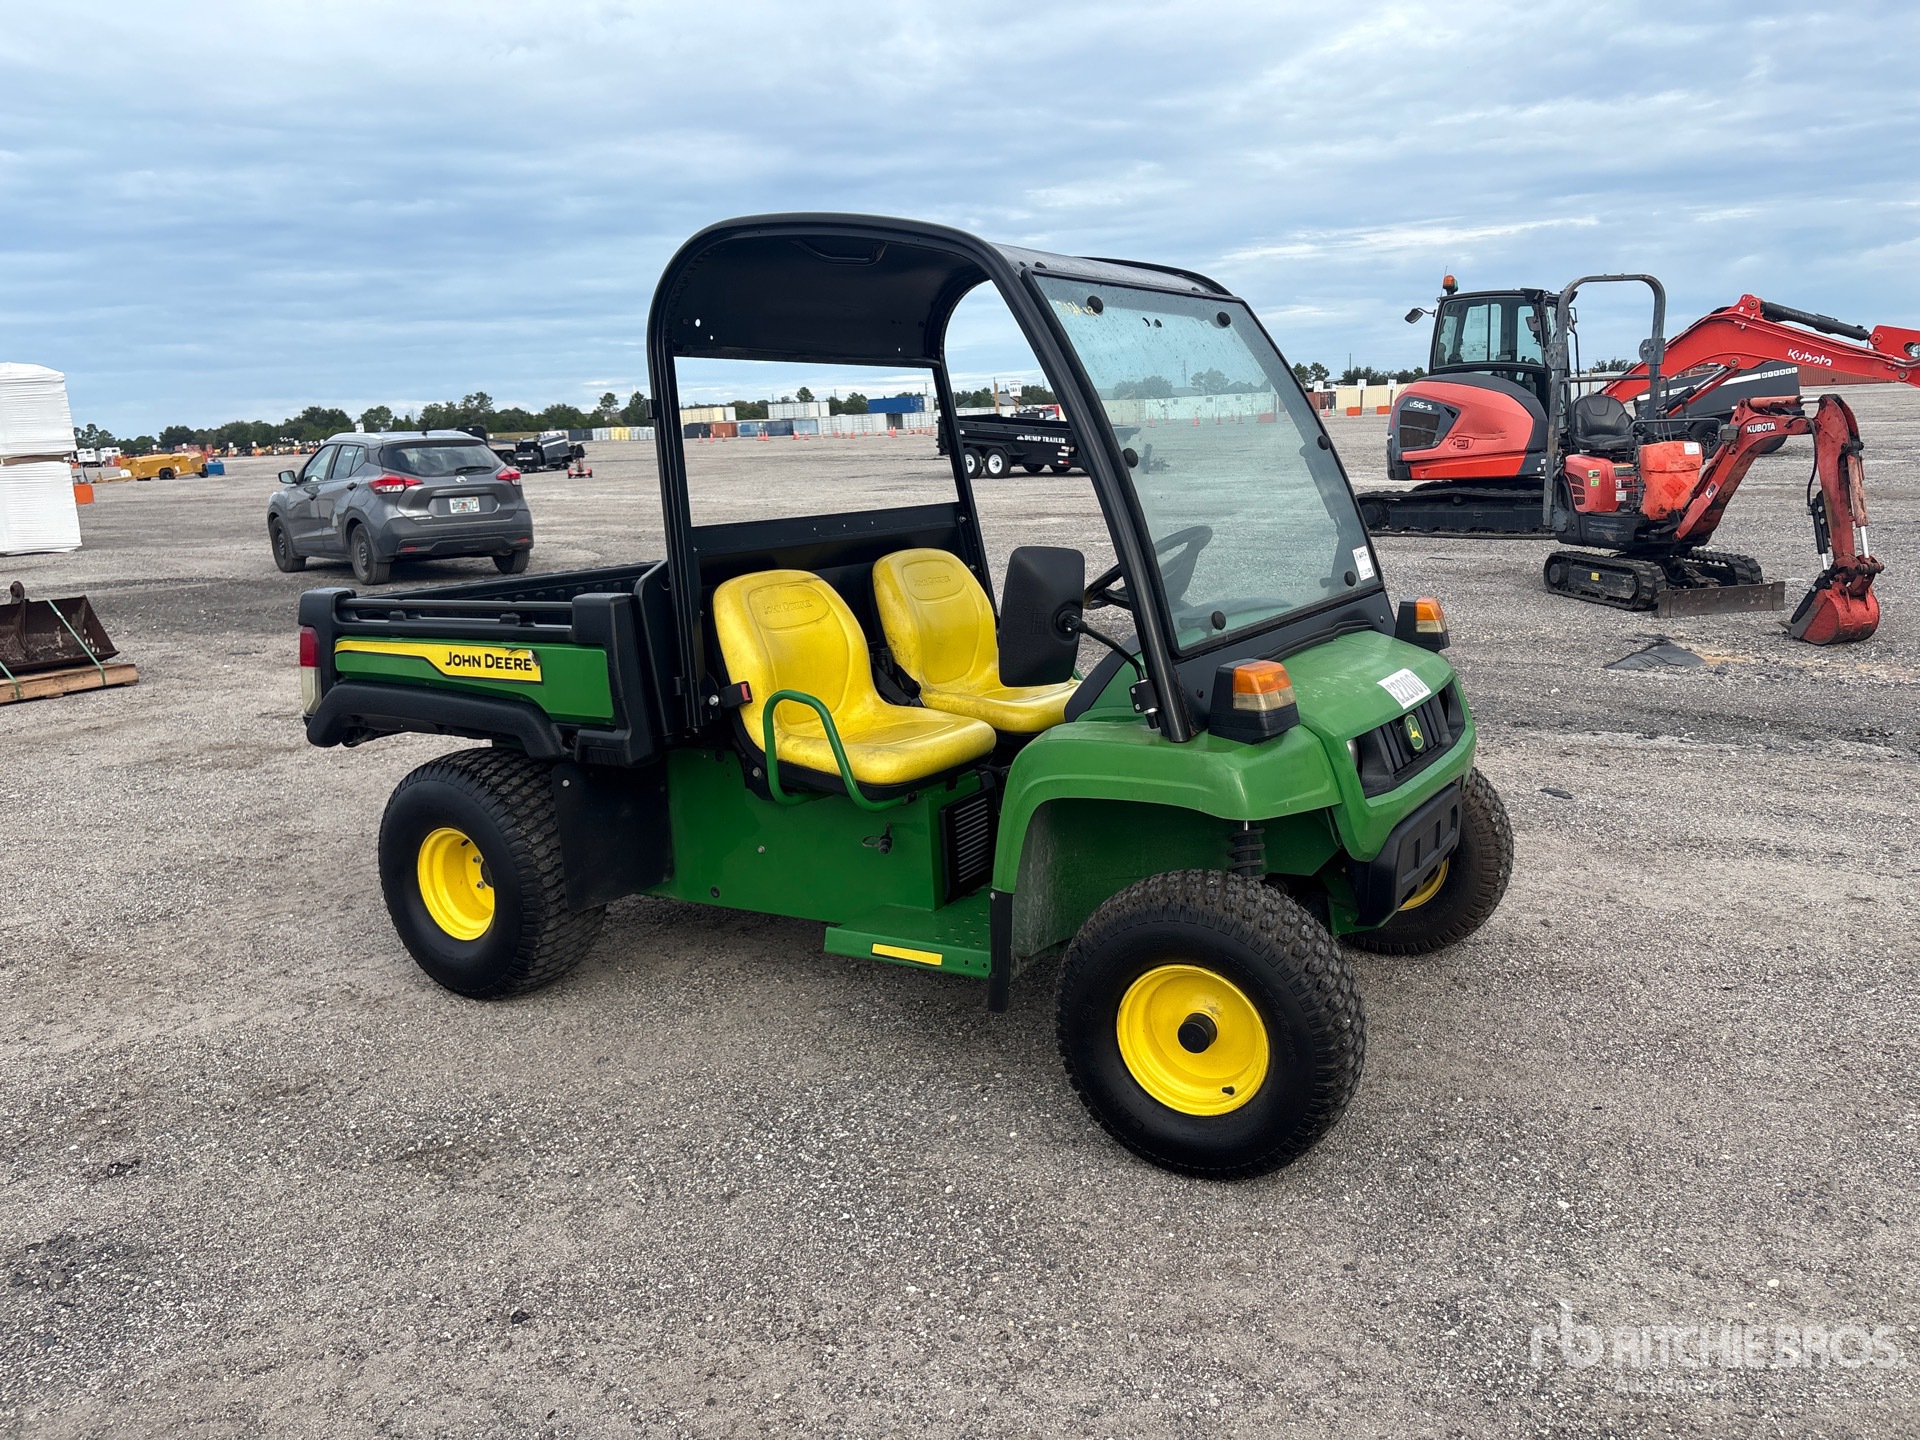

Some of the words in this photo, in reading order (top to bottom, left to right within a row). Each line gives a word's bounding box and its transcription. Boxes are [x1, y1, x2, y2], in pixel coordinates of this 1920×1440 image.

[1787, 348, 1833, 367] Kubota
[1746, 422, 1776, 434] KUBOTA
[1024, 434, 1041, 442] DUMP
[1042, 436, 1066, 444] TRAILER
[445, 651, 481, 668] JOHN
[484, 653, 532, 671] DEERE
